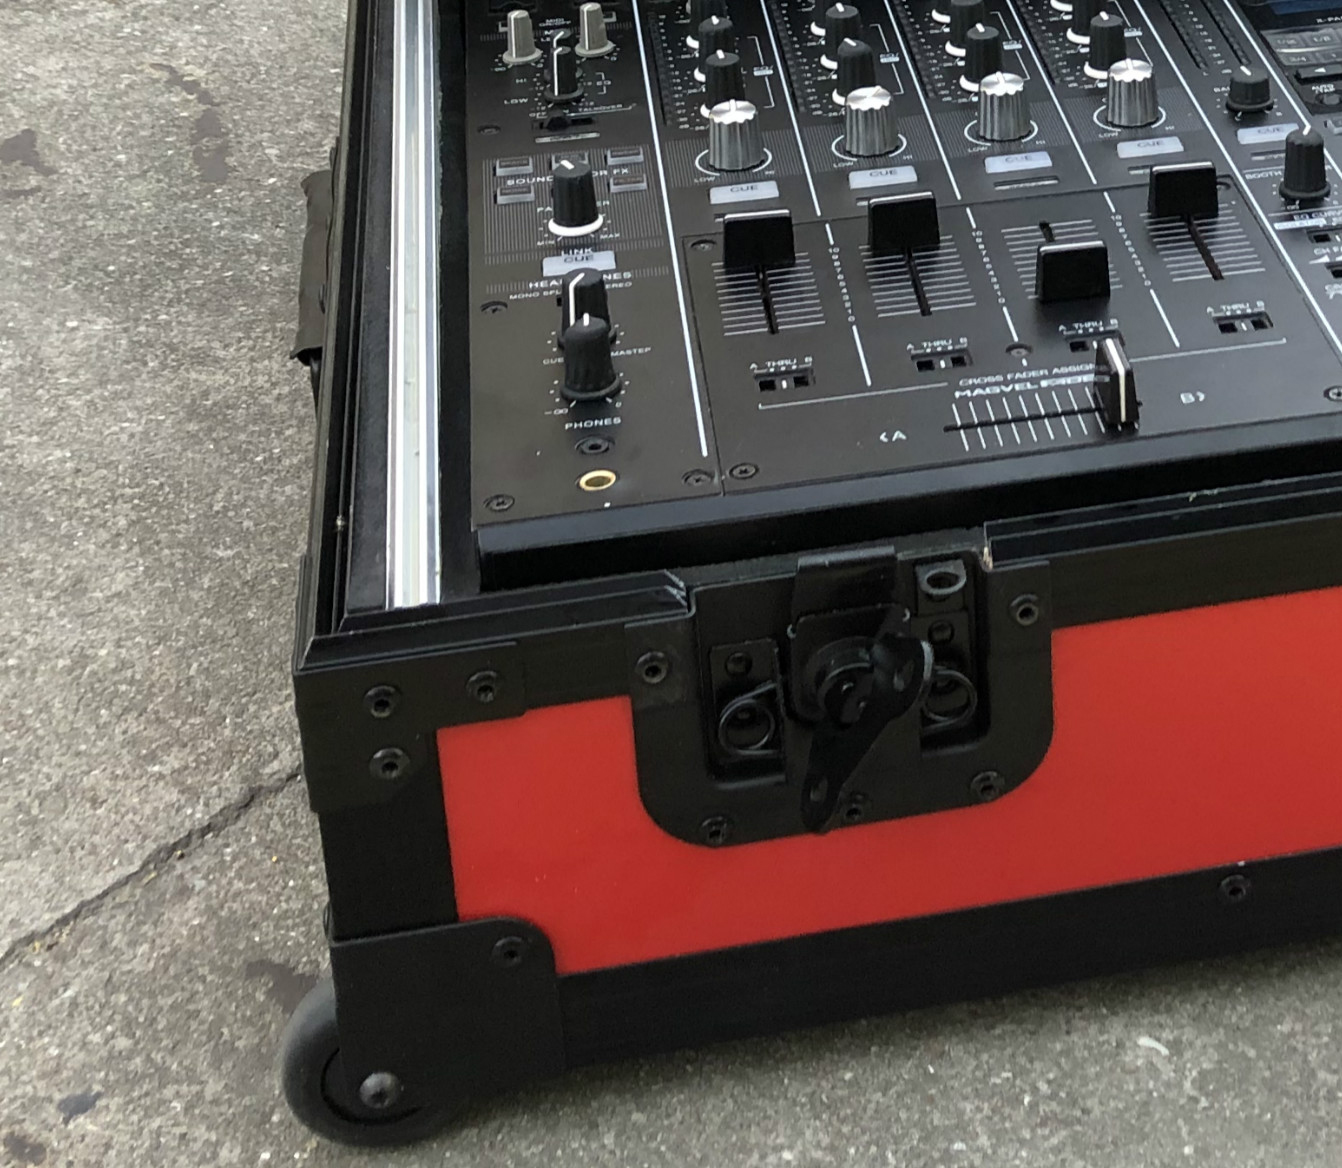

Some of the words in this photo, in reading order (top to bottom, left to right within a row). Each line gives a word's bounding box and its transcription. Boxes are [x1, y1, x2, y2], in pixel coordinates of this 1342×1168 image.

[504, 97, 528, 105] LOW
[1136, 139, 1165, 148] CUE
[1004, 154, 1033, 163] CUE
[613, 167, 630, 175] FX
[869, 169, 898, 178] CUE
[1245, 170, 1283, 180] BOOTH
[729, 184, 758, 193] CUE
[1293, 213, 1309, 221] EQ
[561, 247, 593, 257] LINK
[1314, 247, 1331, 255] CH
[563, 255, 595, 263] CUE
[509, 291, 540, 300] MONO
[1220, 301, 1250, 311] THRU
[1073, 320, 1103, 329] THRU
[921, 338, 953, 348] THRU
[542, 357, 565, 365] CUE
[765, 358, 797, 367] THRU
[958, 375, 1004, 387] CROSS
[1006, 369, 1050, 381] FADER
[564, 416, 622, 430] PHONES
